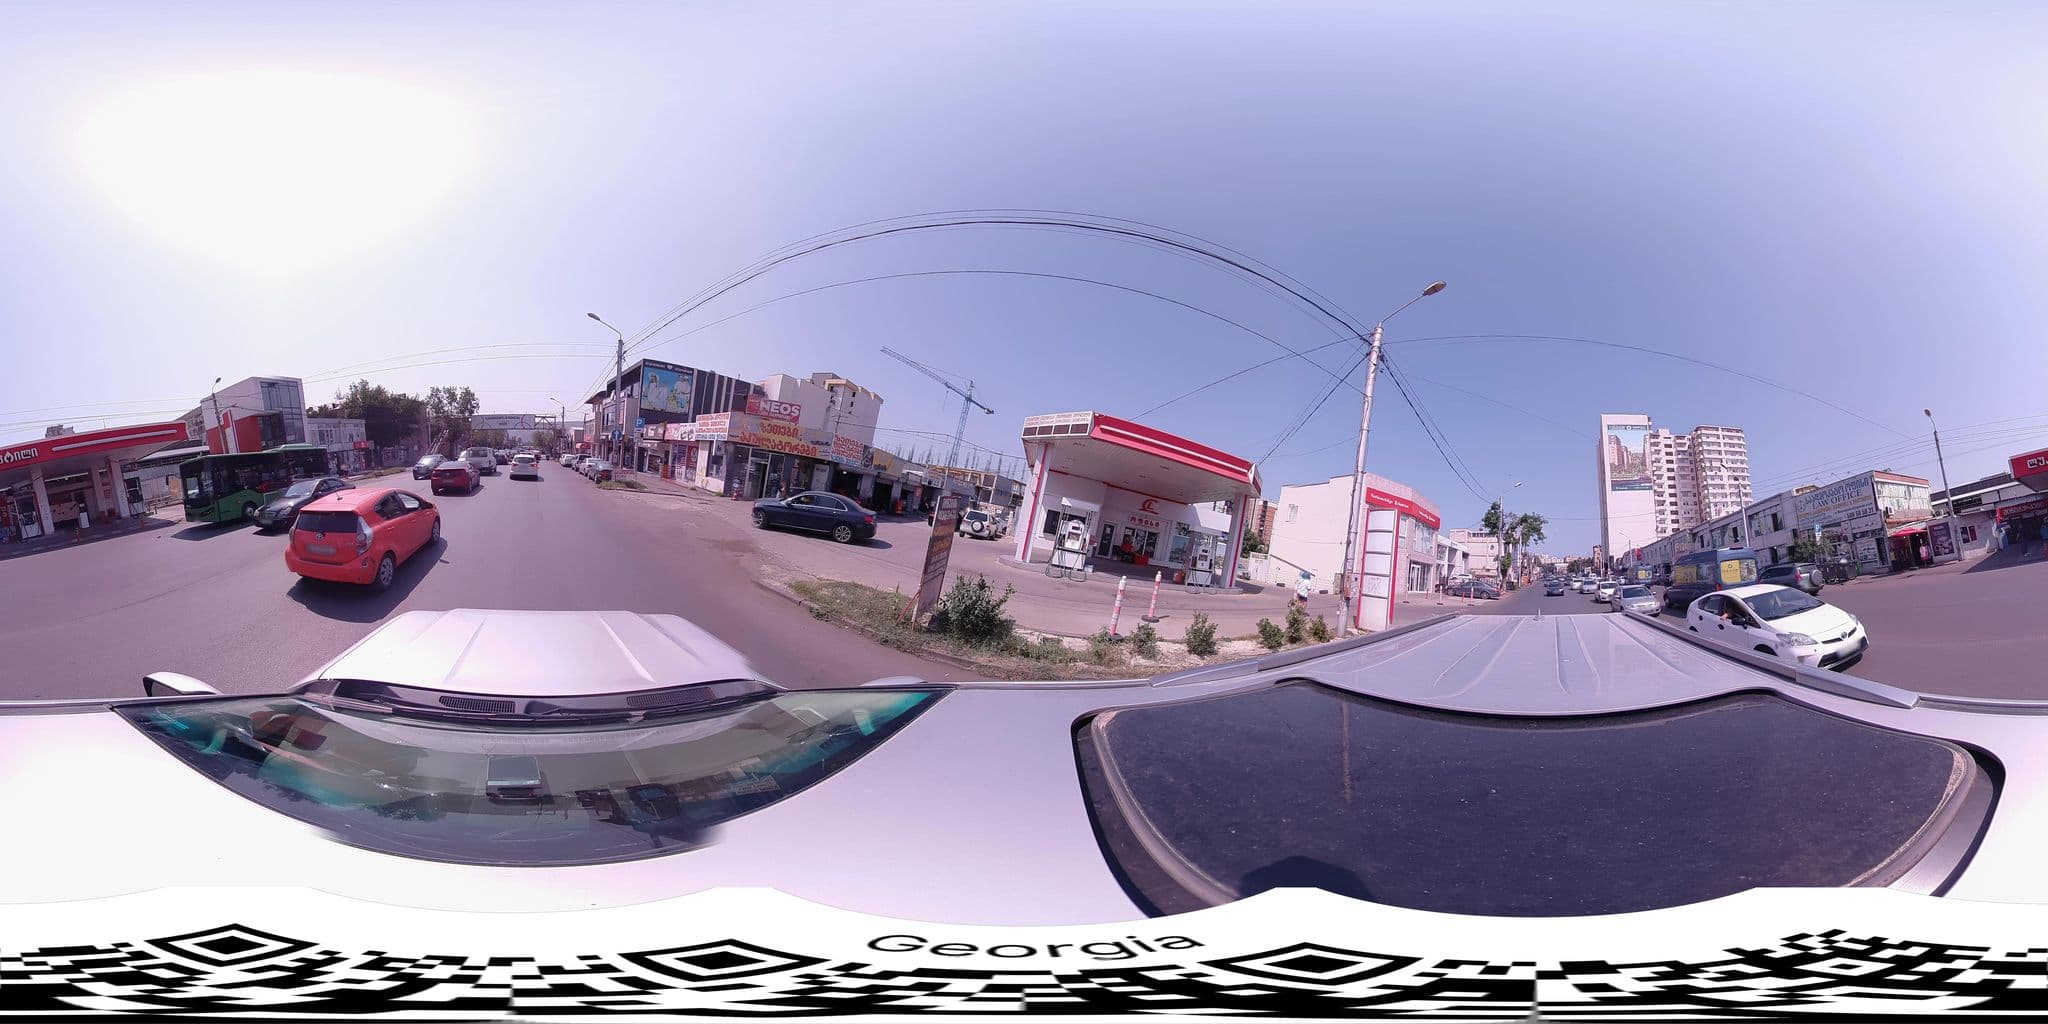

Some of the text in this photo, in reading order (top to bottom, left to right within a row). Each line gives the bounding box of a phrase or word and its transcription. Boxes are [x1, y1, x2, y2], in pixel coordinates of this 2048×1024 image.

[760, 422, 799, 438] ზეთები
[1812, 498, 1830, 510] LAW
[1830, 489, 1862, 504] OFFICE
